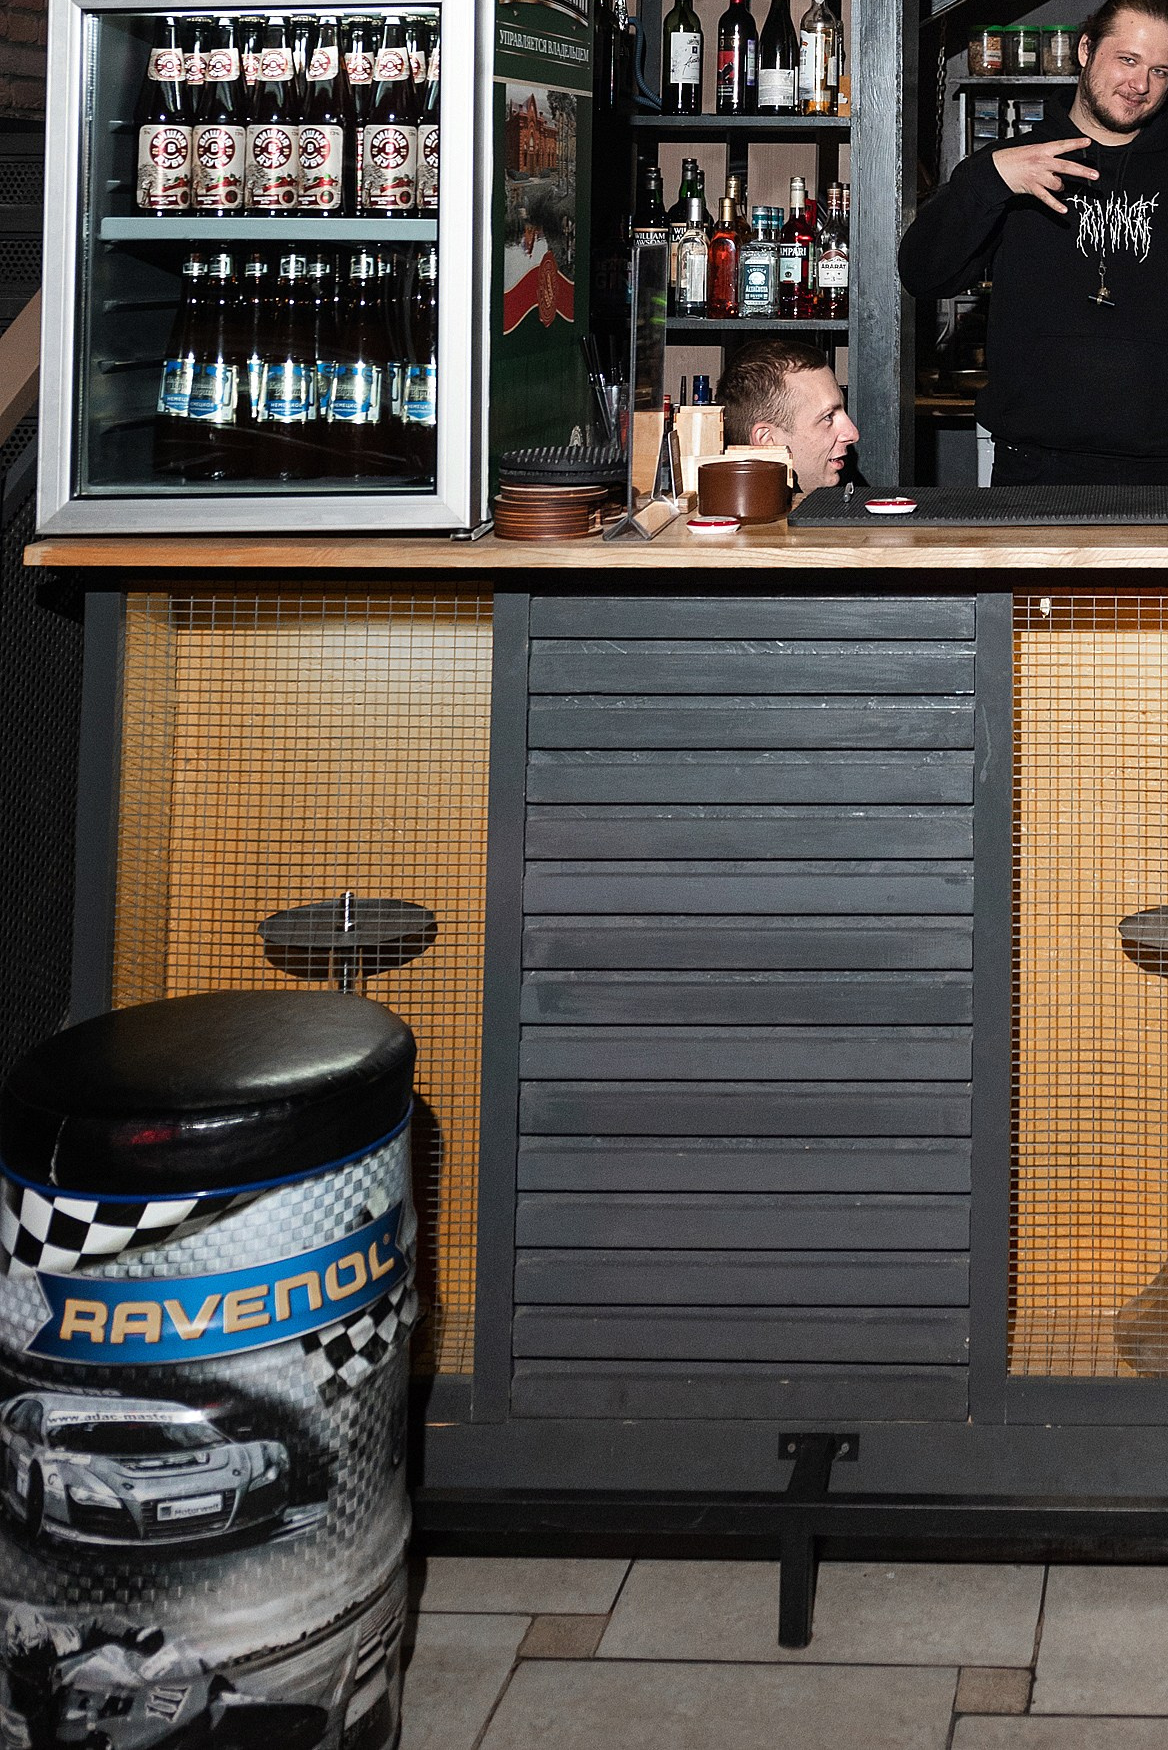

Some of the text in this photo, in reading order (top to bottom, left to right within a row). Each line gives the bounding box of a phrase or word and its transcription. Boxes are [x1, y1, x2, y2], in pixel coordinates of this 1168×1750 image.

[499, 29, 589, 62] УПРАВЛЯЕТСЯ ВЛАДЕЛЬЦЕМ
[152, 129, 188, 147] ВИШНЯ
[198, 129, 235, 147] ВИШНЯ
[254, 129, 290, 146] ВИШНЯ
[372, 129, 407, 146] ВИШНЯ
[154, 154, 185, 168] ДУБЕ
[200, 154, 230, 168] ДУБЕ
[256, 154, 287, 167] ДУБЕ
[373, 155, 404, 167] ДУБЕ
[634, 232, 666, 240] WILLIAM
[59, 1241, 395, 1344] RAVENOL
